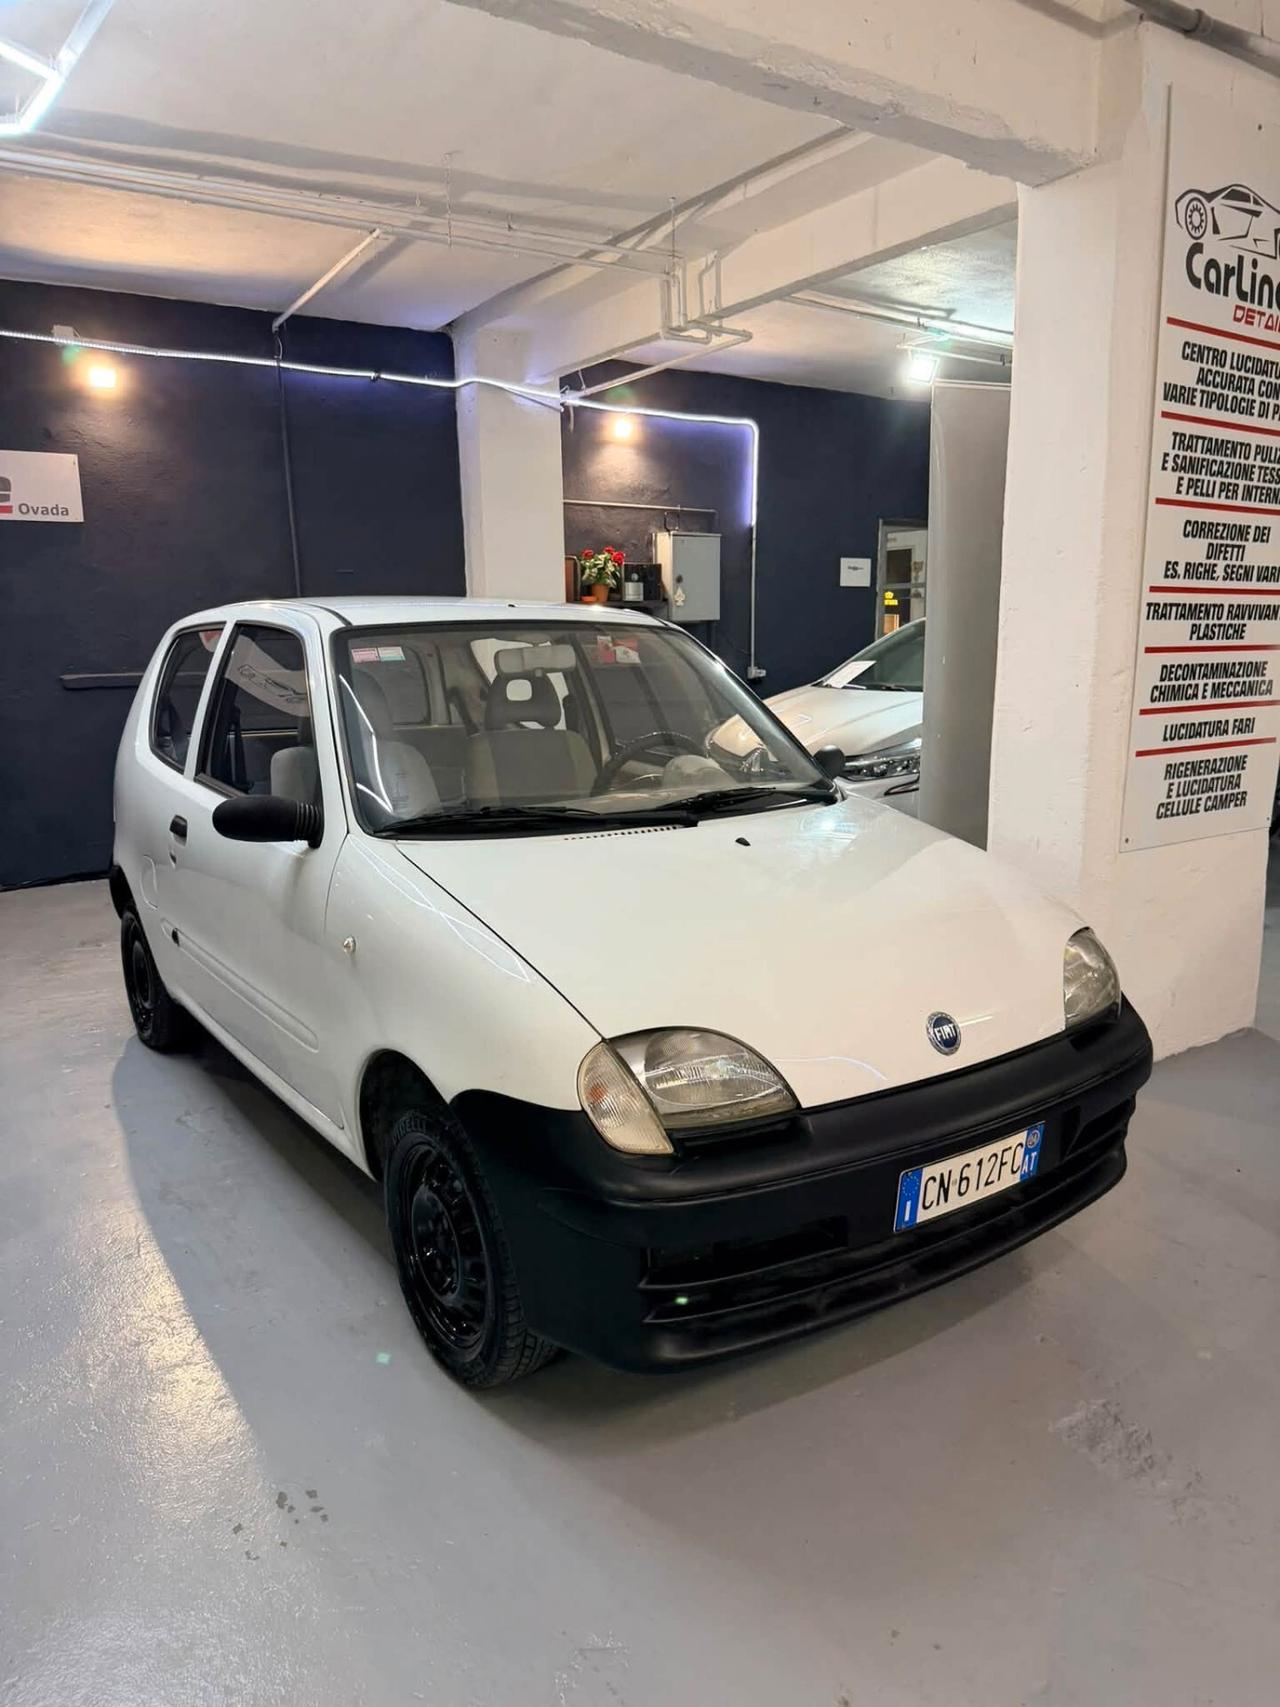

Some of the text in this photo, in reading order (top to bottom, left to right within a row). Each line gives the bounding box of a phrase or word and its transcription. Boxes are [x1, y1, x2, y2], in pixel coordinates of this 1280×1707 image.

[1181, 341, 1228, 369] CENTRO
[1196, 367, 1280, 401] ACCURATA CON
[1163, 382, 1280, 421] VARIE TIPOLOGIE DI P
[1171, 431, 1251, 460] TRATTAMENTO
[1161, 452, 1170, 471] E
[1171, 453, 1256, 482] SANIFICAZIONE
[1176, 476, 1280, 505] E PELLI PER INTERN
[18, 502, 69, 516] Ovada
[1183, 519, 1271, 543] CORREZIONE DEI
[1205, 543, 1246, 562] DIFETTI
[1163, 561, 1181, 580] ES.
[1183, 562, 1219, 582] RIGHE,
[1222, 563, 1255, 582] SEGNI
[1146, 602, 1280, 621] TRATTAMENTO RAVVIVAN
[1189, 623, 1246, 641] PLASTICHE
[1159, 661, 1268, 682] DECONTAMINAZIONE
[1150, 680, 1274, 703] CHIMICA E MECCANICA
[1162, 717, 1256, 742] LUCIDATURA FARI
[1164, 755, 1248, 781] RIGENERAZIONE
[1166, 773, 1242, 799] E LUCIDATURA
[1156, 791, 1248, 820] CELLULE CAMPER
[934, 1023, 956, 1041] FIAT
[922, 1169, 952, 1210] CN
[957, 1142, 1024, 1197] 612FC
[1021, 1151, 1037, 1175] AT
